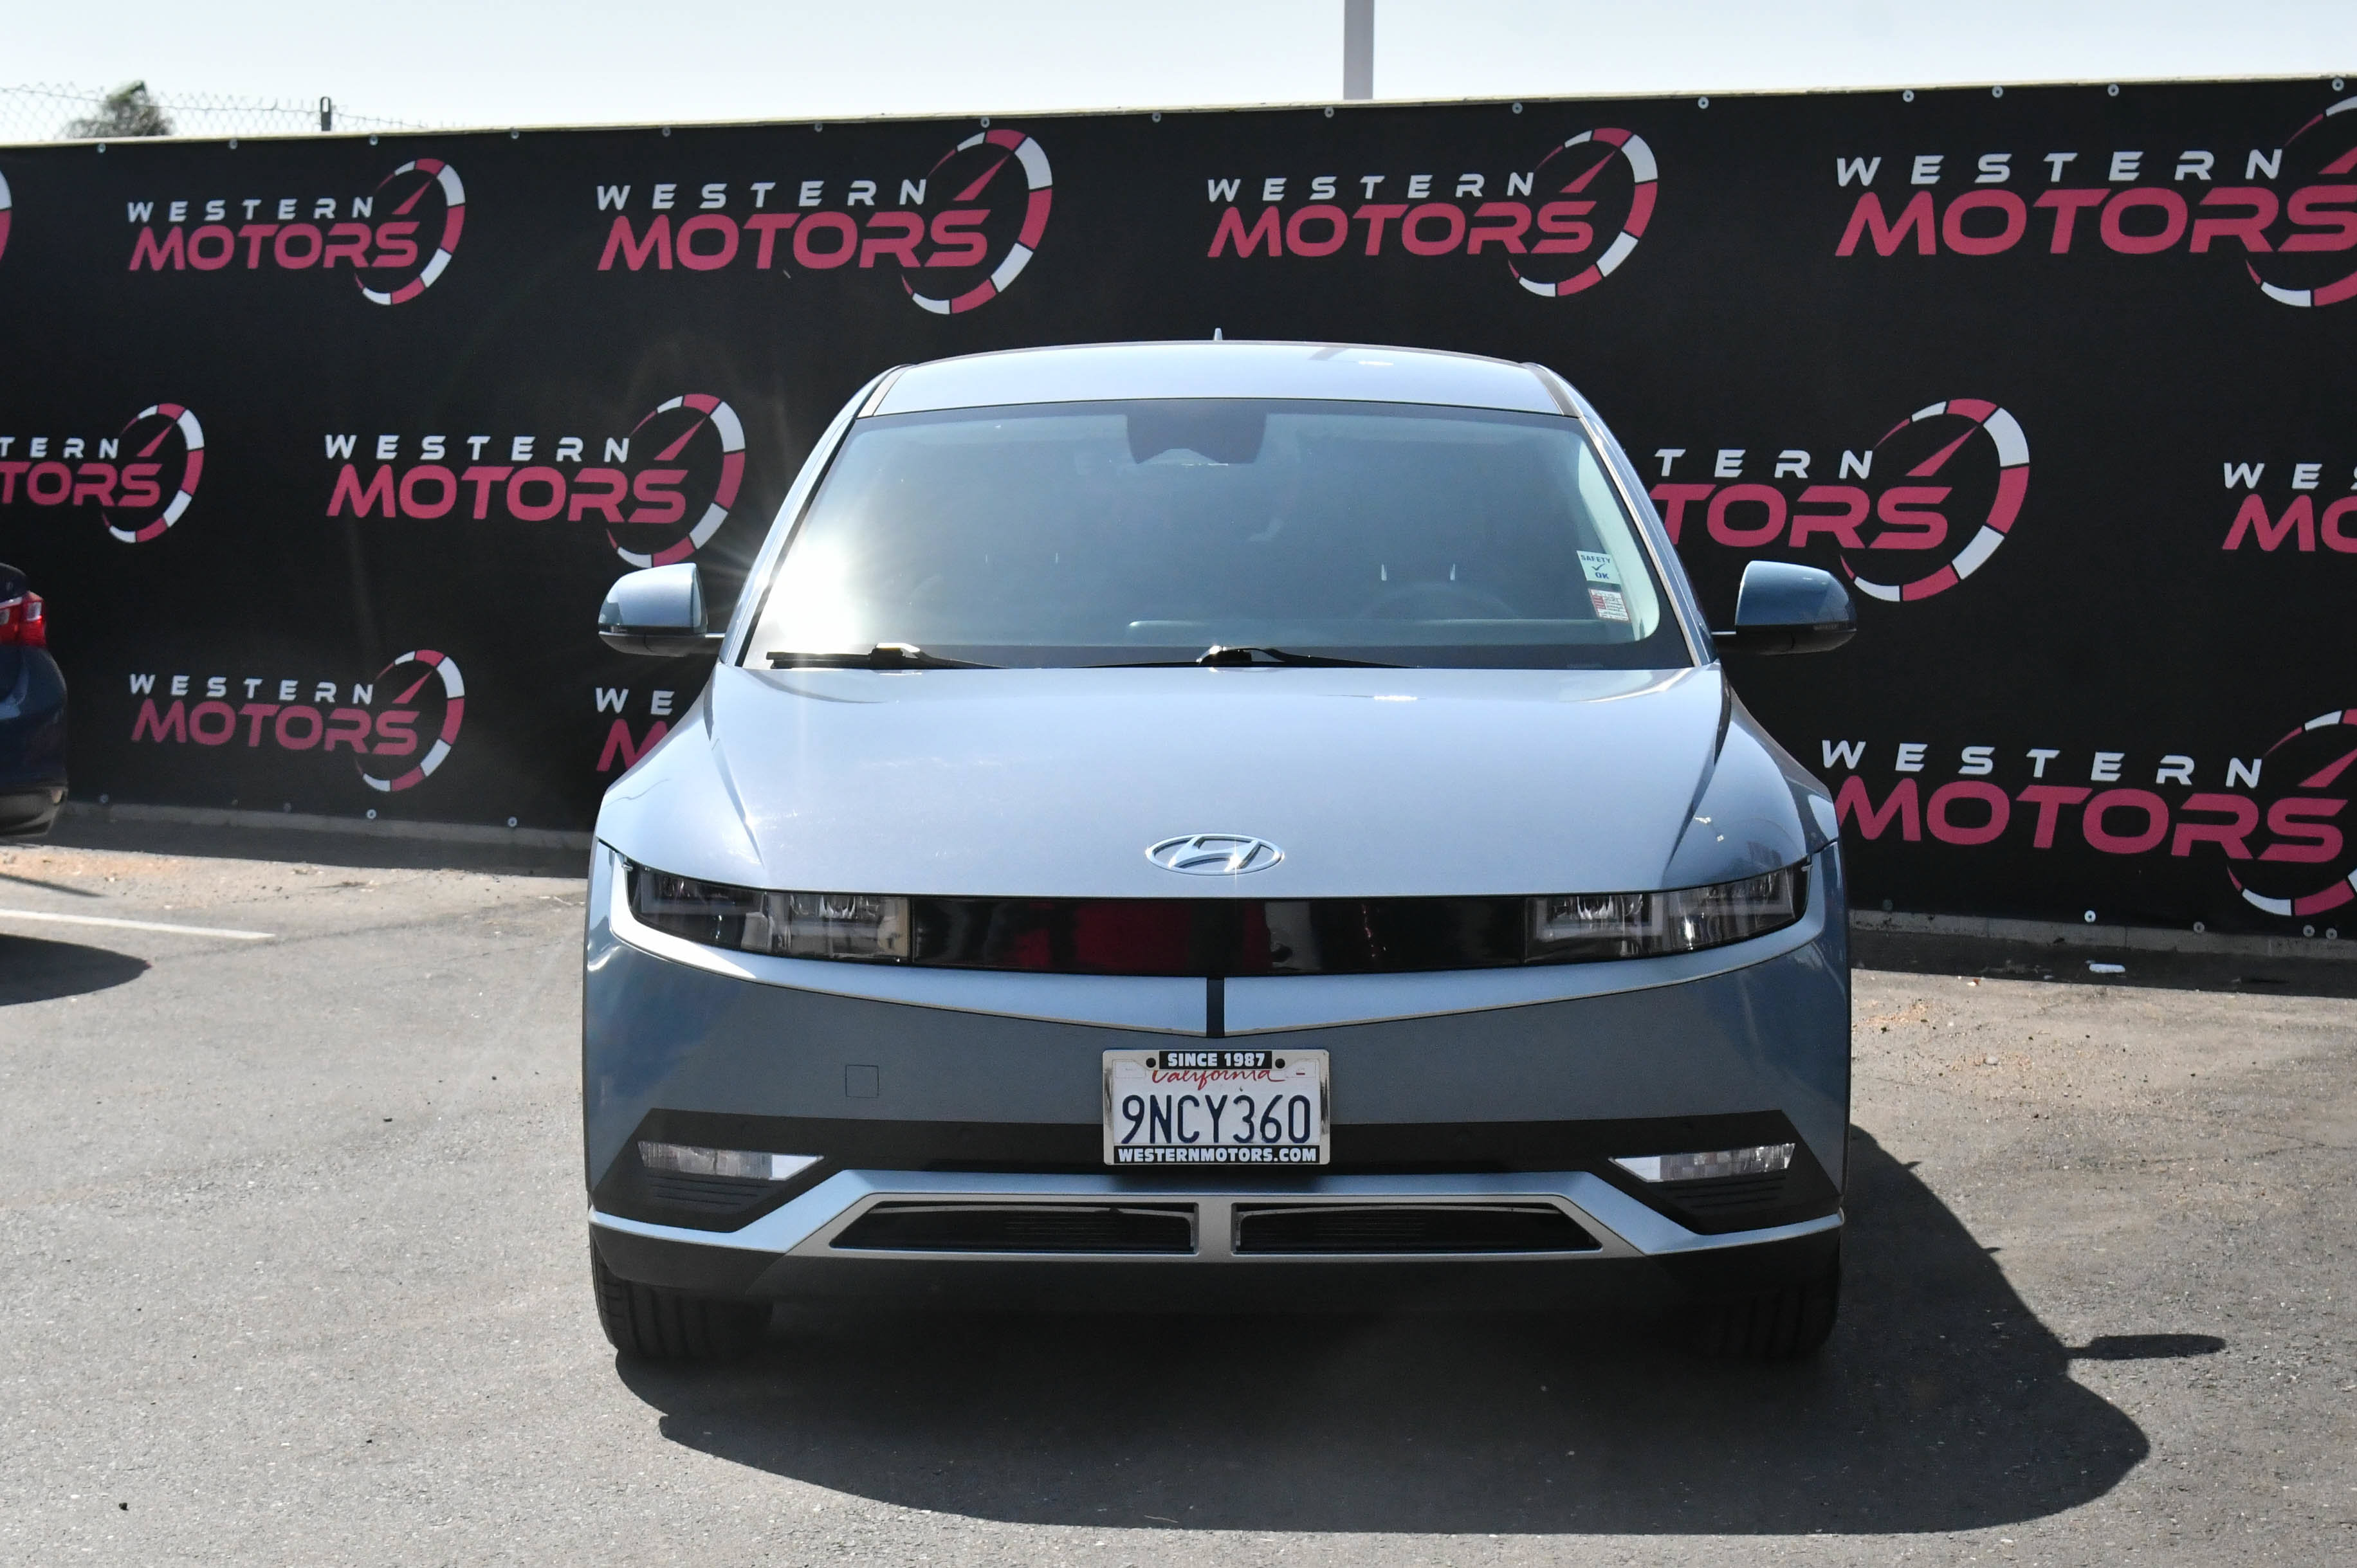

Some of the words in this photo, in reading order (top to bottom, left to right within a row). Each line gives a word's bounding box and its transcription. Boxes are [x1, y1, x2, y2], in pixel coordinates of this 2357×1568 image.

[1207, 172, 1534, 202] WESTERN
[1837, 149, 2283, 187] WESTERN
[128, 197, 374, 223] WESTERN
[597, 179, 927, 210] WESTERN
[597, 209, 991, 271] MOTORS
[1207, 201, 1597, 258] MOTORS
[1835, 185, 2357, 257] MOTORS
[129, 221, 420, 271] MOTORS
[325, 434, 630, 463] WESTERN
[326, 464, 688, 524] MOTORS
[1581, 555, 1611, 563] SAFETY
[131, 673, 374, 705] WESTERN
[132, 698, 419, 756] MOTORS
[1821, 739, 2263, 789] WESTERN
[1834, 775, 2348, 863] MOTORS
[1168, 1053, 1218, 1067] SINCE
[1224, 1053, 1265, 1067] 1987
[1121, 1095, 1311, 1144] 9NCY360
[1118, 1147, 1317, 1162] WESTERNMOTORS.COM
